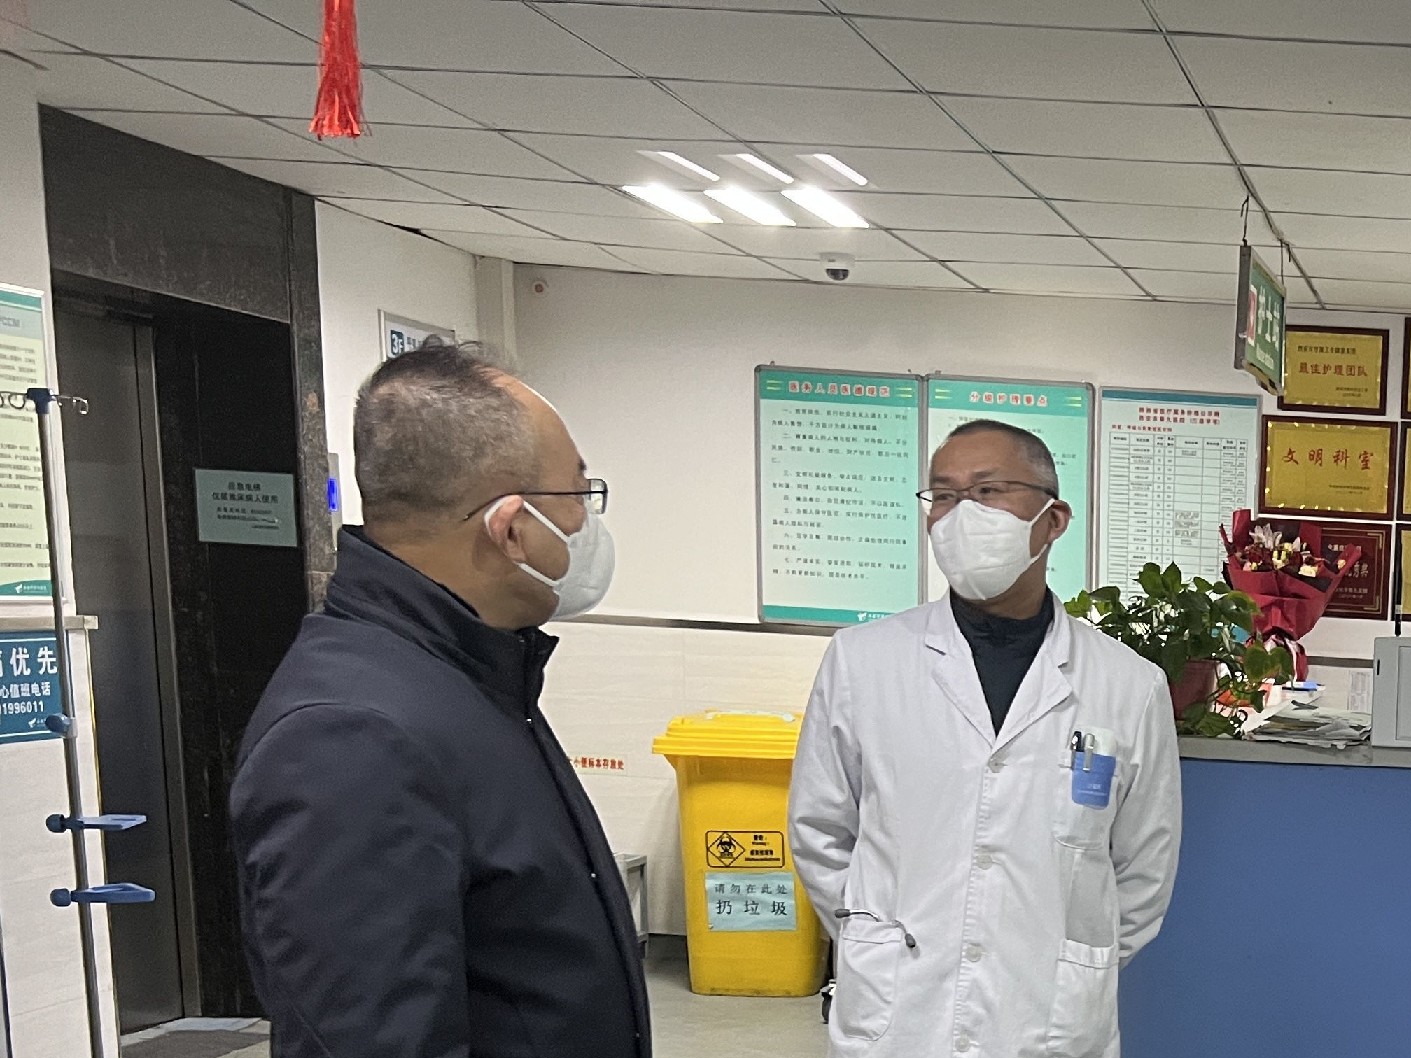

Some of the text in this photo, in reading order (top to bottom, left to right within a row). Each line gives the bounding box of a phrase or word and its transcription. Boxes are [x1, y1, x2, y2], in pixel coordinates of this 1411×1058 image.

[1299, 362, 1368, 378] 最佳护理团队
[1283, 448, 1374, 470] 文明科室
[1345, 560, 1369, 578] 秀奖
[0, 645, 57, 677] 优先
[0, 699, 44, 715] 1996011
[570, 757, 625, 770] 小便标本存放处
[715, 883, 788, 895] 请勿在此处
[716, 899, 788, 916] 扔垃圾
